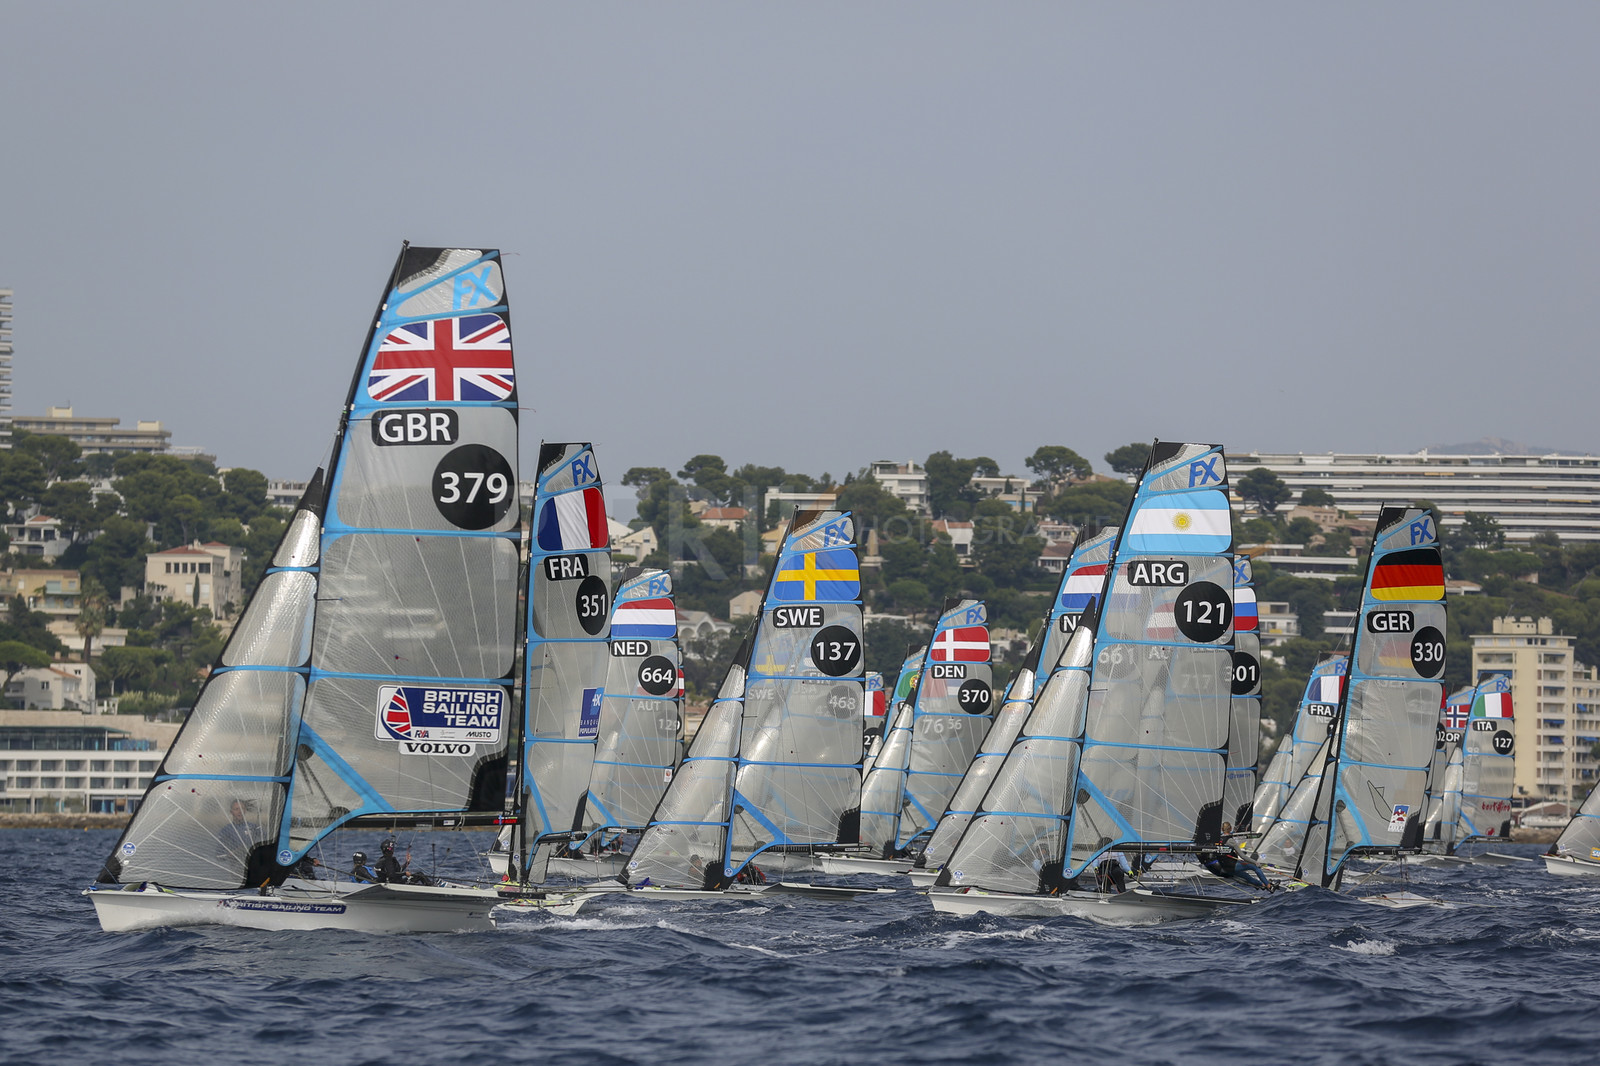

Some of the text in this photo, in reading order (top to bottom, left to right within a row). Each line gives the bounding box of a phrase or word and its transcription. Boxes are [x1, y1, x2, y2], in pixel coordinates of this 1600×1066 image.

[452, 266, 499, 310] FX
[379, 412, 451, 442] GBR
[571, 454, 595, 486] FX
[1188, 457, 1221, 488] FX
[439, 472, 508, 504] 379
[824, 520, 850, 547] FX
[1410, 519, 1433, 546] FX
[549, 557, 585, 579] FRA
[1132, 563, 1185, 584] ARG
[648, 576, 669, 597] FX
[581, 594, 606, 617] 351
[1183, 600, 1226, 625] 121
[776, 608, 821, 626] SWE
[966, 607, 984, 624] FX
[1372, 613, 1410, 631] GER
[614, 642, 648, 655] NED
[816, 642, 856, 661] 137
[1414, 643, 1443, 662] 330
[641, 668, 673, 684] 664
[934, 666, 964, 678] DEN
[1224, 666, 1256, 682] 301
[868, 677, 880, 689] FX
[424, 691, 498, 703] BRITISH
[748, 689, 775, 700] SWE
[829, 695, 856, 710] 468
[961, 690, 989, 704] 370
[423, 702, 498, 715] SAILING
[637, 701, 661, 711] AUT
[1310, 704, 1332, 716] FRA
[444, 714, 497, 727] TEAM
[1477, 721, 1493, 731] ITA
[414, 729, 430, 739] RYA
[1445, 732, 1460, 742] OR
[404, 742, 471, 755] VOLVO
[1494, 737, 1512, 748] 127
[315, 905, 342, 913] TEAM
